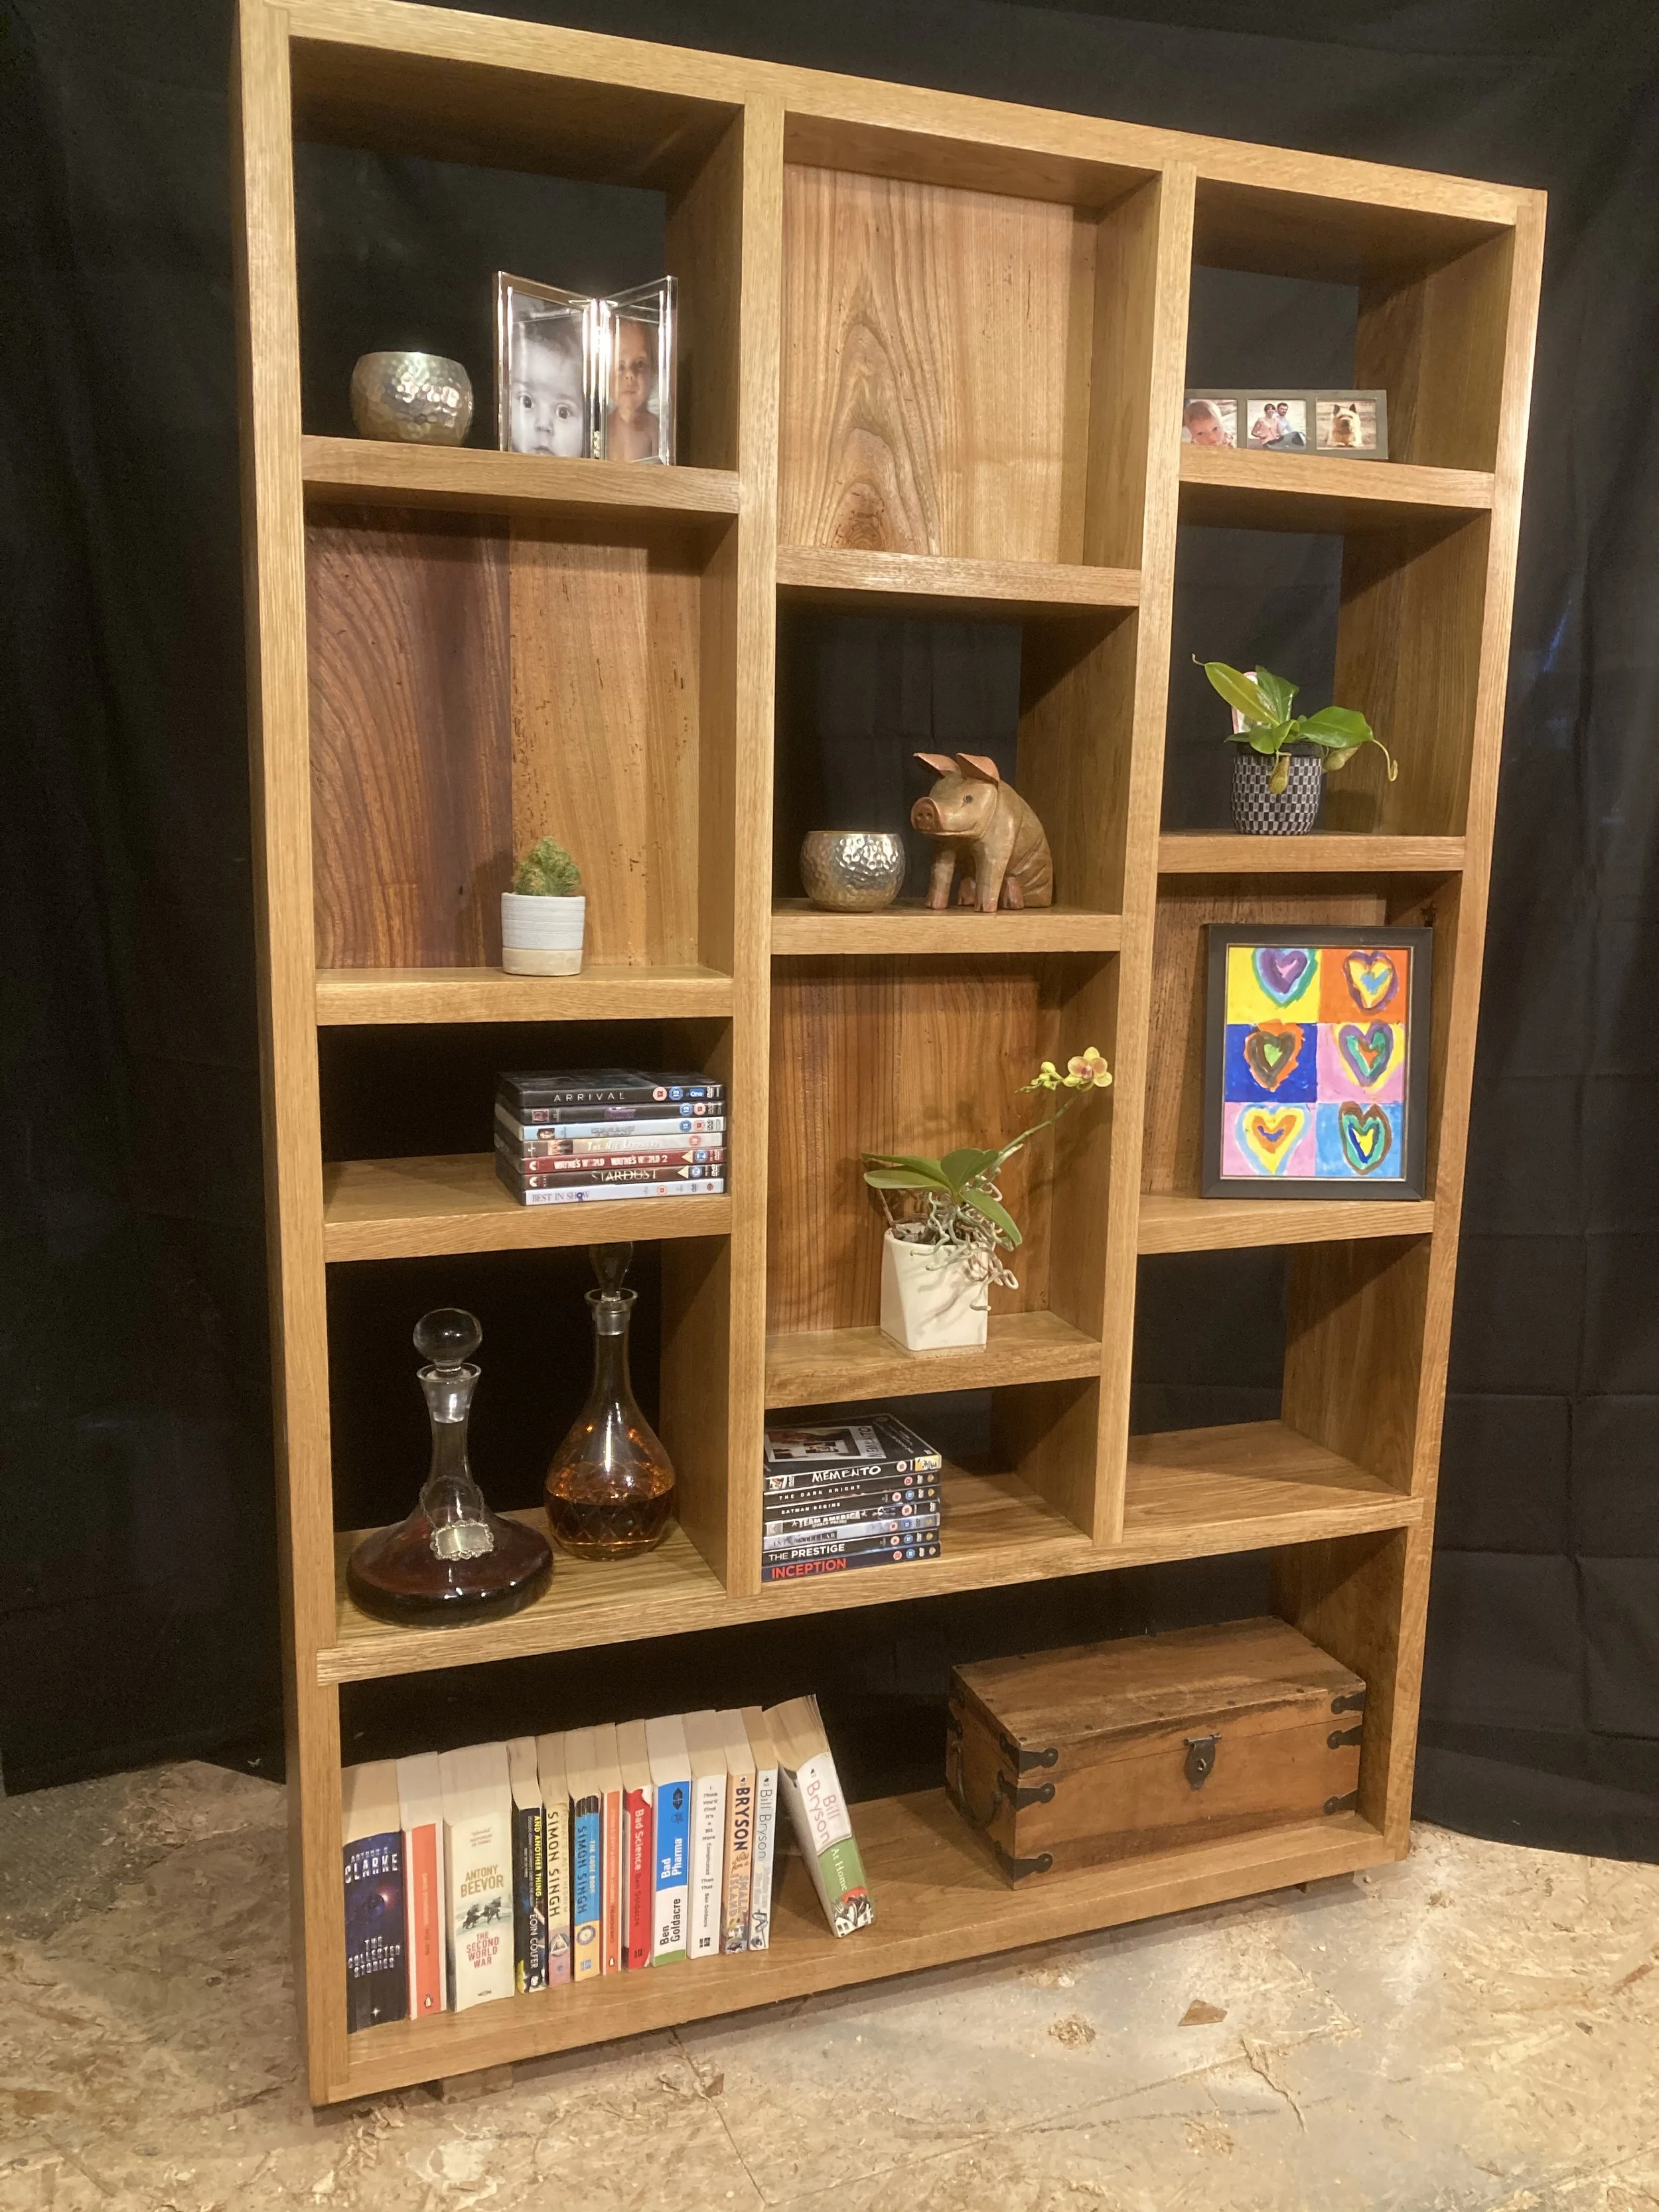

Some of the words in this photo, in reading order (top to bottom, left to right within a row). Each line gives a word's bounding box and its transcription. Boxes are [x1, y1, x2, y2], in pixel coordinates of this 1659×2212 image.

[554, 1092, 625, 1102] ARRIVAL
[554, 1159, 581, 1169] WAYNE'S
[611, 1156, 636, 1166] WAYNE'S
[591, 1169, 658, 1182] STARDUST
[532, 1193, 552, 1203] BEST
[566, 1191, 589, 1201] SHOW
[812, 1465, 882, 1483] MEMENTO
[829, 1485, 861, 1493] KNIGHT
[799, 1518, 821, 1528] TEAM
[823, 1511, 861, 1522] AMERICA
[769, 1552, 788, 1561] THE
[791, 1544, 845, 1558] PRESTIGE
[772, 1558, 847, 1579] INCEPTION
[760, 1789, 772, 1809] Bill
[823, 1795, 841, 1819] Bill
[634, 1808, 644, 1829] Bad
[734, 1787, 751, 1852] BRYSON
[807, 1779, 830, 1846] Bryson
[547, 1811, 559, 1862] SIMON
[577, 1826, 587, 1868] SIMON
[757, 1813, 772, 1860] Bryson
[634, 1831, 644, 1870] Science
[671, 1838, 682, 1876] Pharma
[831, 1848, 840, 1861] At
[344, 1854, 398, 1883] CLARKE
[465, 1864, 498, 1882] ANTONY
[661, 1858, 671, 1879] Bad
[835, 1862, 848, 1891] Home
[461, 1875, 504, 1898] BEEVOR
[549, 1868, 561, 1917] SINGH
[577, 1873, 587, 1914] SINGH
[729, 1874, 739, 1917] ISLAND
[737, 1874, 749, 1913] SMALL
[529, 1914, 538, 1936] EOIN
[671, 1898, 681, 1943] Goldacre
[365, 1936, 382, 1947] THE
[466, 1936, 499, 1953] SECOND
[476, 1931, 489, 1940] THE
[660, 1925, 670, 1946] Ben
[348, 1945, 400, 1968] COLLECTED
[468, 1945, 498, 1962] WORLD
[473, 1958, 492, 1969] WAR
[530, 1939, 539, 1969] COLFER
[354, 1957, 395, 1978] STORIES
